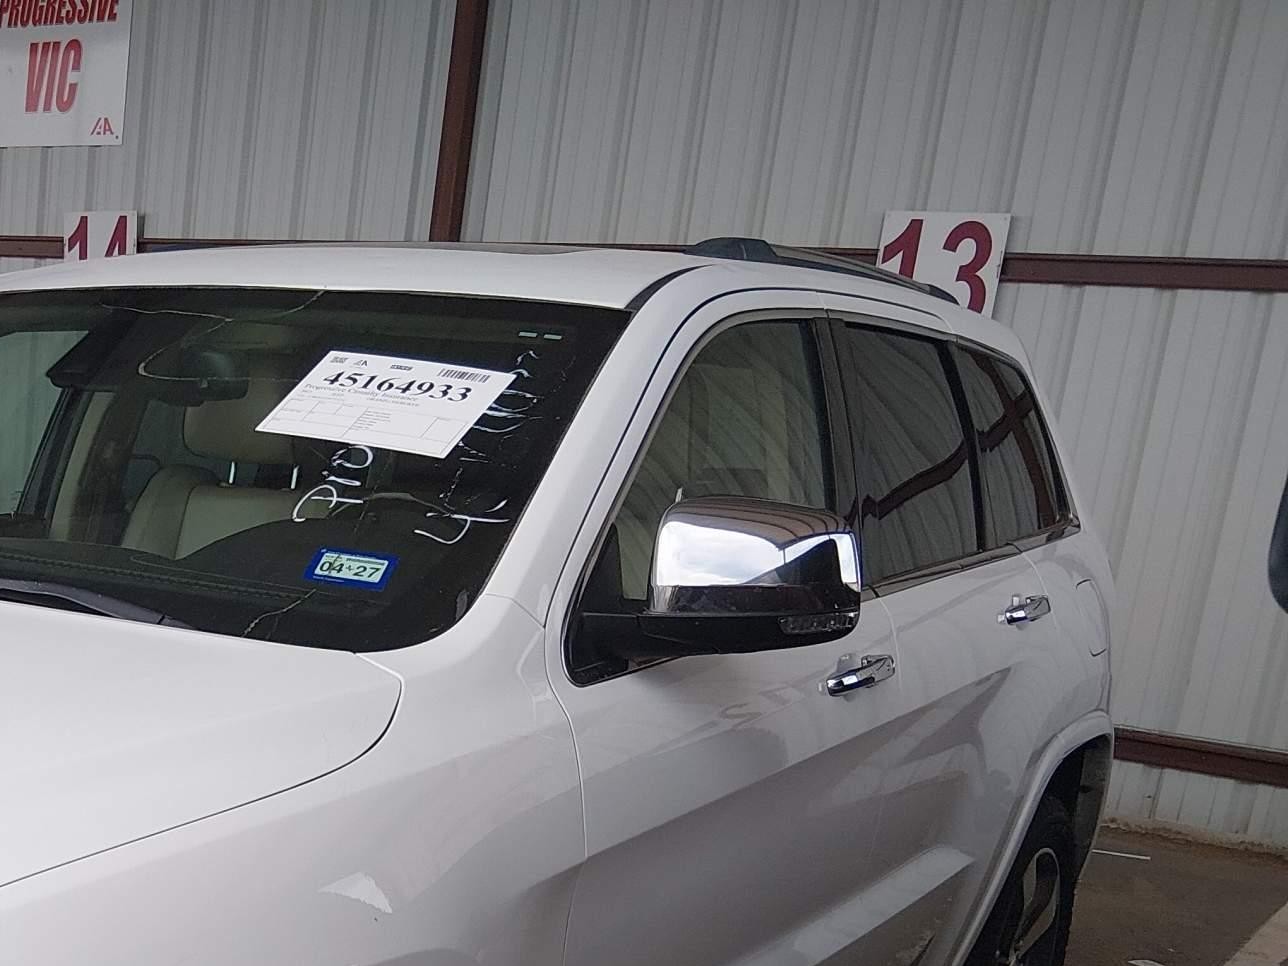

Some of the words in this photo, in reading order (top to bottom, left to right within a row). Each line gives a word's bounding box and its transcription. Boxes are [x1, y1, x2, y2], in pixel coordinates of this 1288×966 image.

[25, 38, 82, 113] VIC
[881, 218, 992, 314] 13
[323, 370, 472, 402] 45164933
